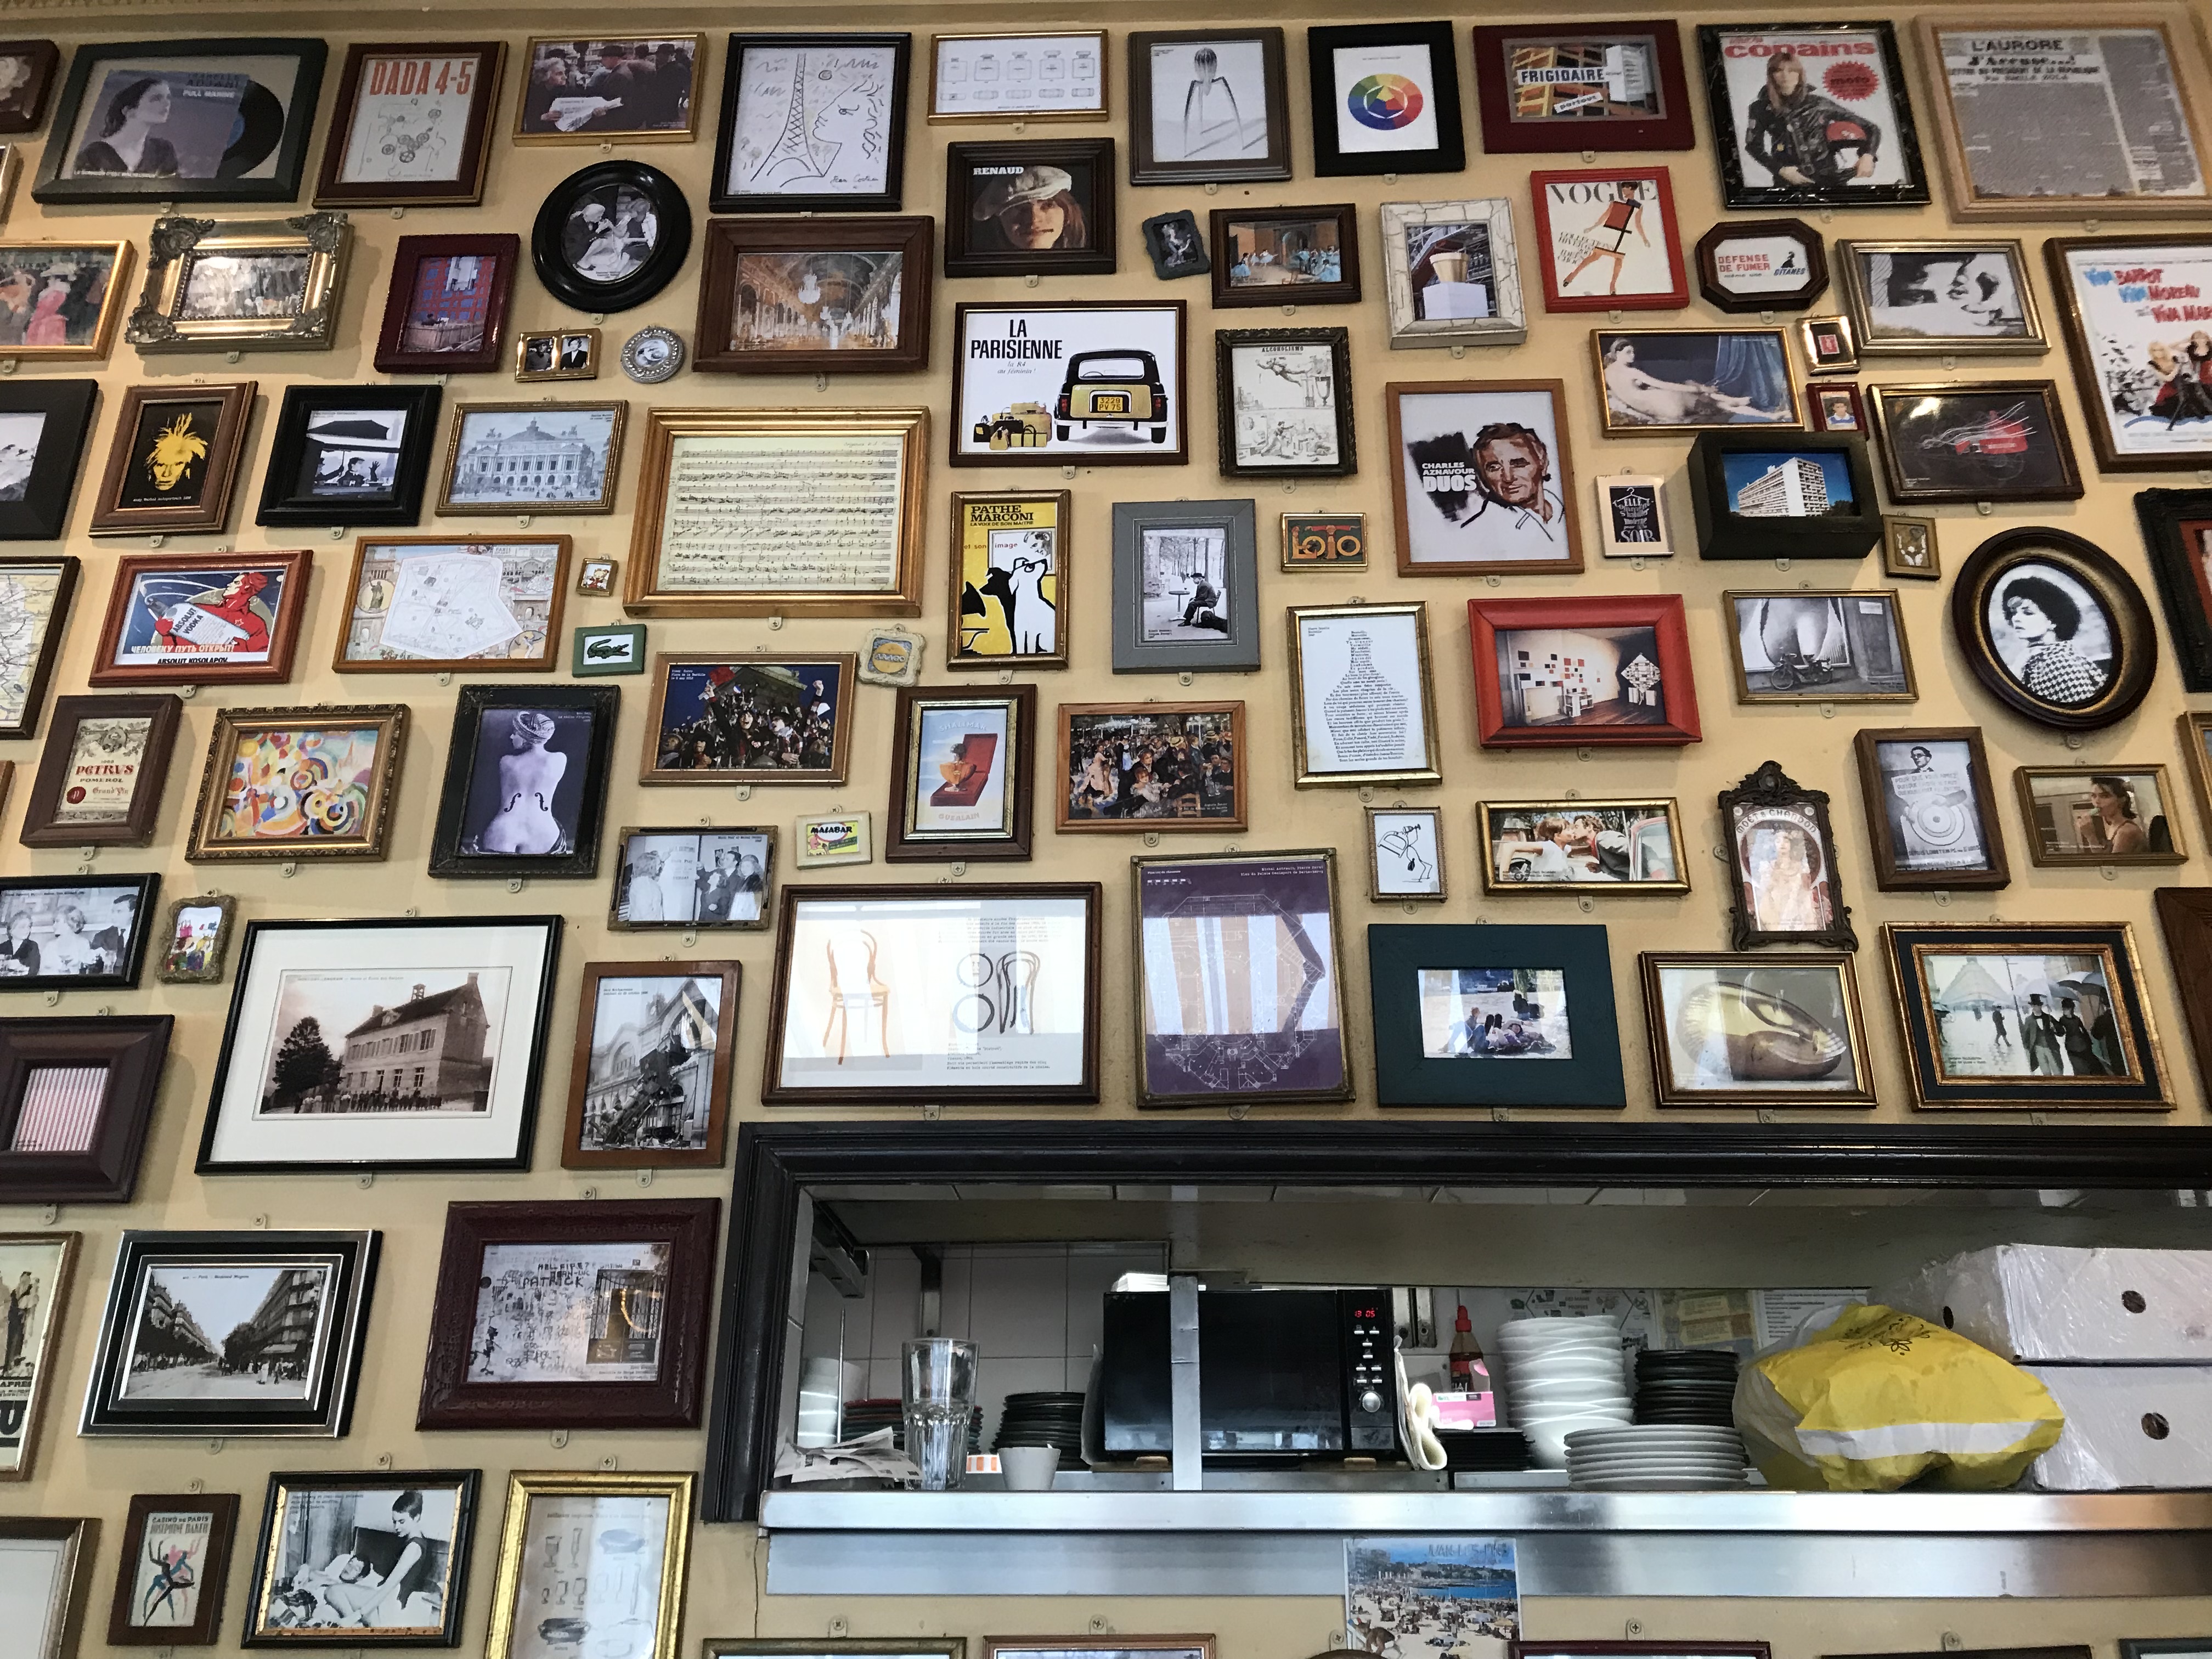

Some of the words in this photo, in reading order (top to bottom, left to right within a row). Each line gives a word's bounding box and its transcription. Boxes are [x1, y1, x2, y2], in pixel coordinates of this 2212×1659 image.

[1725, 42, 1876, 58] copains
[1972, 40, 2064, 52] L'AURORE
[370, 61, 431, 95] DADA
[435, 61, 474, 95] 4-5
[1521, 67, 1605, 83] FRIGIDAIRE
[973, 166, 1024, 175] RENAUD
[1719, 264, 1733, 273] DE
[1736, 263, 1770, 271] FUMER
[1774, 268, 1805, 276] GITANES
[1009, 319, 1027, 337] LA
[971, 340, 1063, 359] PARISIENNE
[1423, 474, 1477, 492] DUOS
[970, 505, 1021, 514] PATHE
[970, 512, 1034, 522] MARCONI
[1291, 525, 1361, 559] LOTO
[1621, 529, 1657, 542] SOIR
[173, 607, 196, 632] ABSOLUT
[1769, 809, 1817, 833] CHANDON
[522, 1277, 584, 1288] PATRICK
